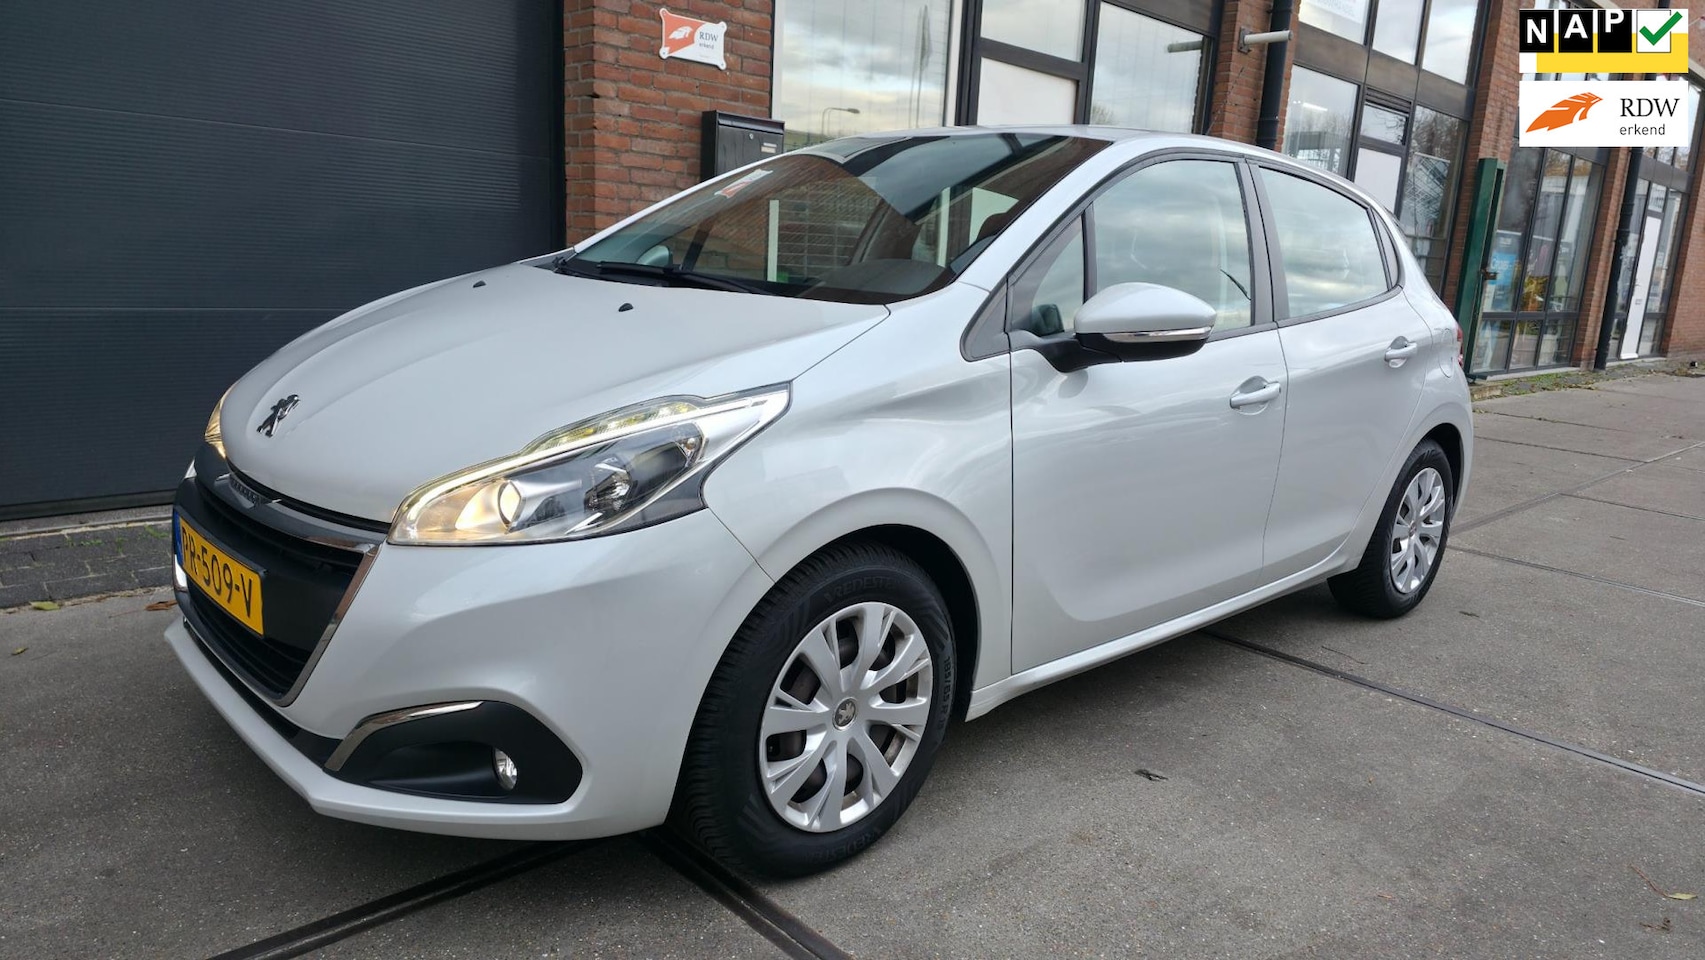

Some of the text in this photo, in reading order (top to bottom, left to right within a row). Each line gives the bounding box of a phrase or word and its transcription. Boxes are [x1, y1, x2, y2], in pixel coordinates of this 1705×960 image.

[699, 31, 718, 42] RDW
[181, 525, 252, 618] PR-509-V
[823, 575, 902, 603] VREDESTE
